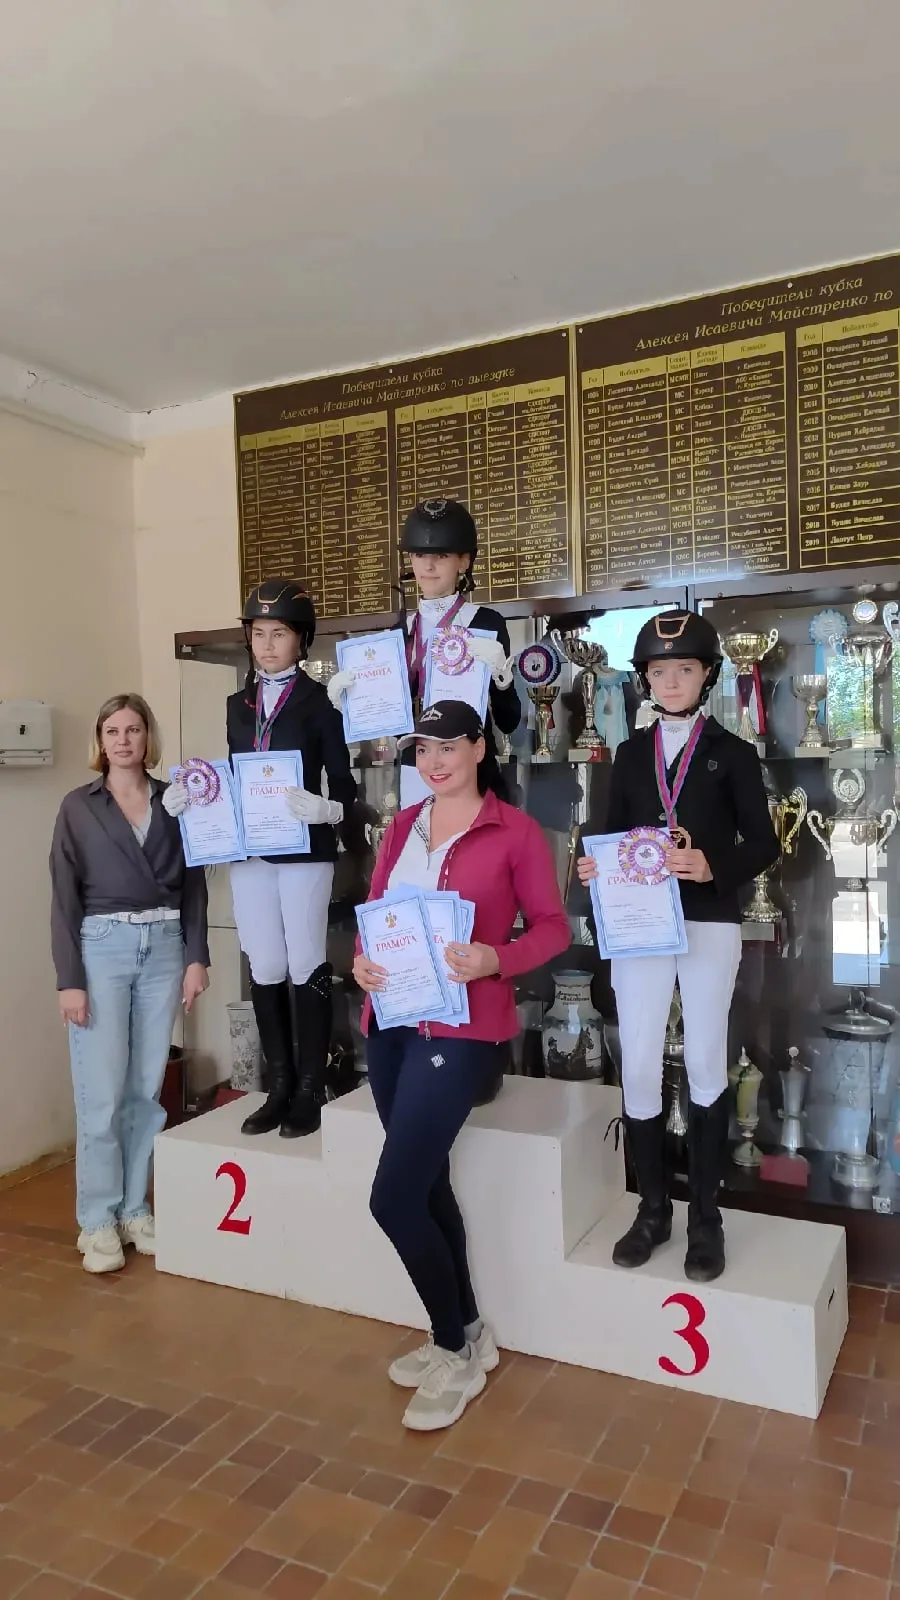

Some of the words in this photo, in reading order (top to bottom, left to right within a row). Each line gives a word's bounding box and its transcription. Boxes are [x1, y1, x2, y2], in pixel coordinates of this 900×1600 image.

[635, 332, 689, 351] Алексея
[694, 316, 763, 339] Исаевича
[769, 296, 868, 324] Майстренко
[873, 290, 893, 303] по
[721, 288, 813, 316] Победители
[818, 277, 864, 297] кубка
[280, 406, 319, 421] Алексея
[323, 397, 373, 413] Исаевича
[376, 382, 447, 402] Майстренко
[451, 378, 464, 389] по
[468, 367, 516, 386] выездке
[342, 373, 409, 395] Победители
[412, 367, 443, 382] кубка
[375, 935, 417, 952] ГРАМОТА
[215, 1161, 252, 1235] 2
[658, 1292, 710, 1377] 3
